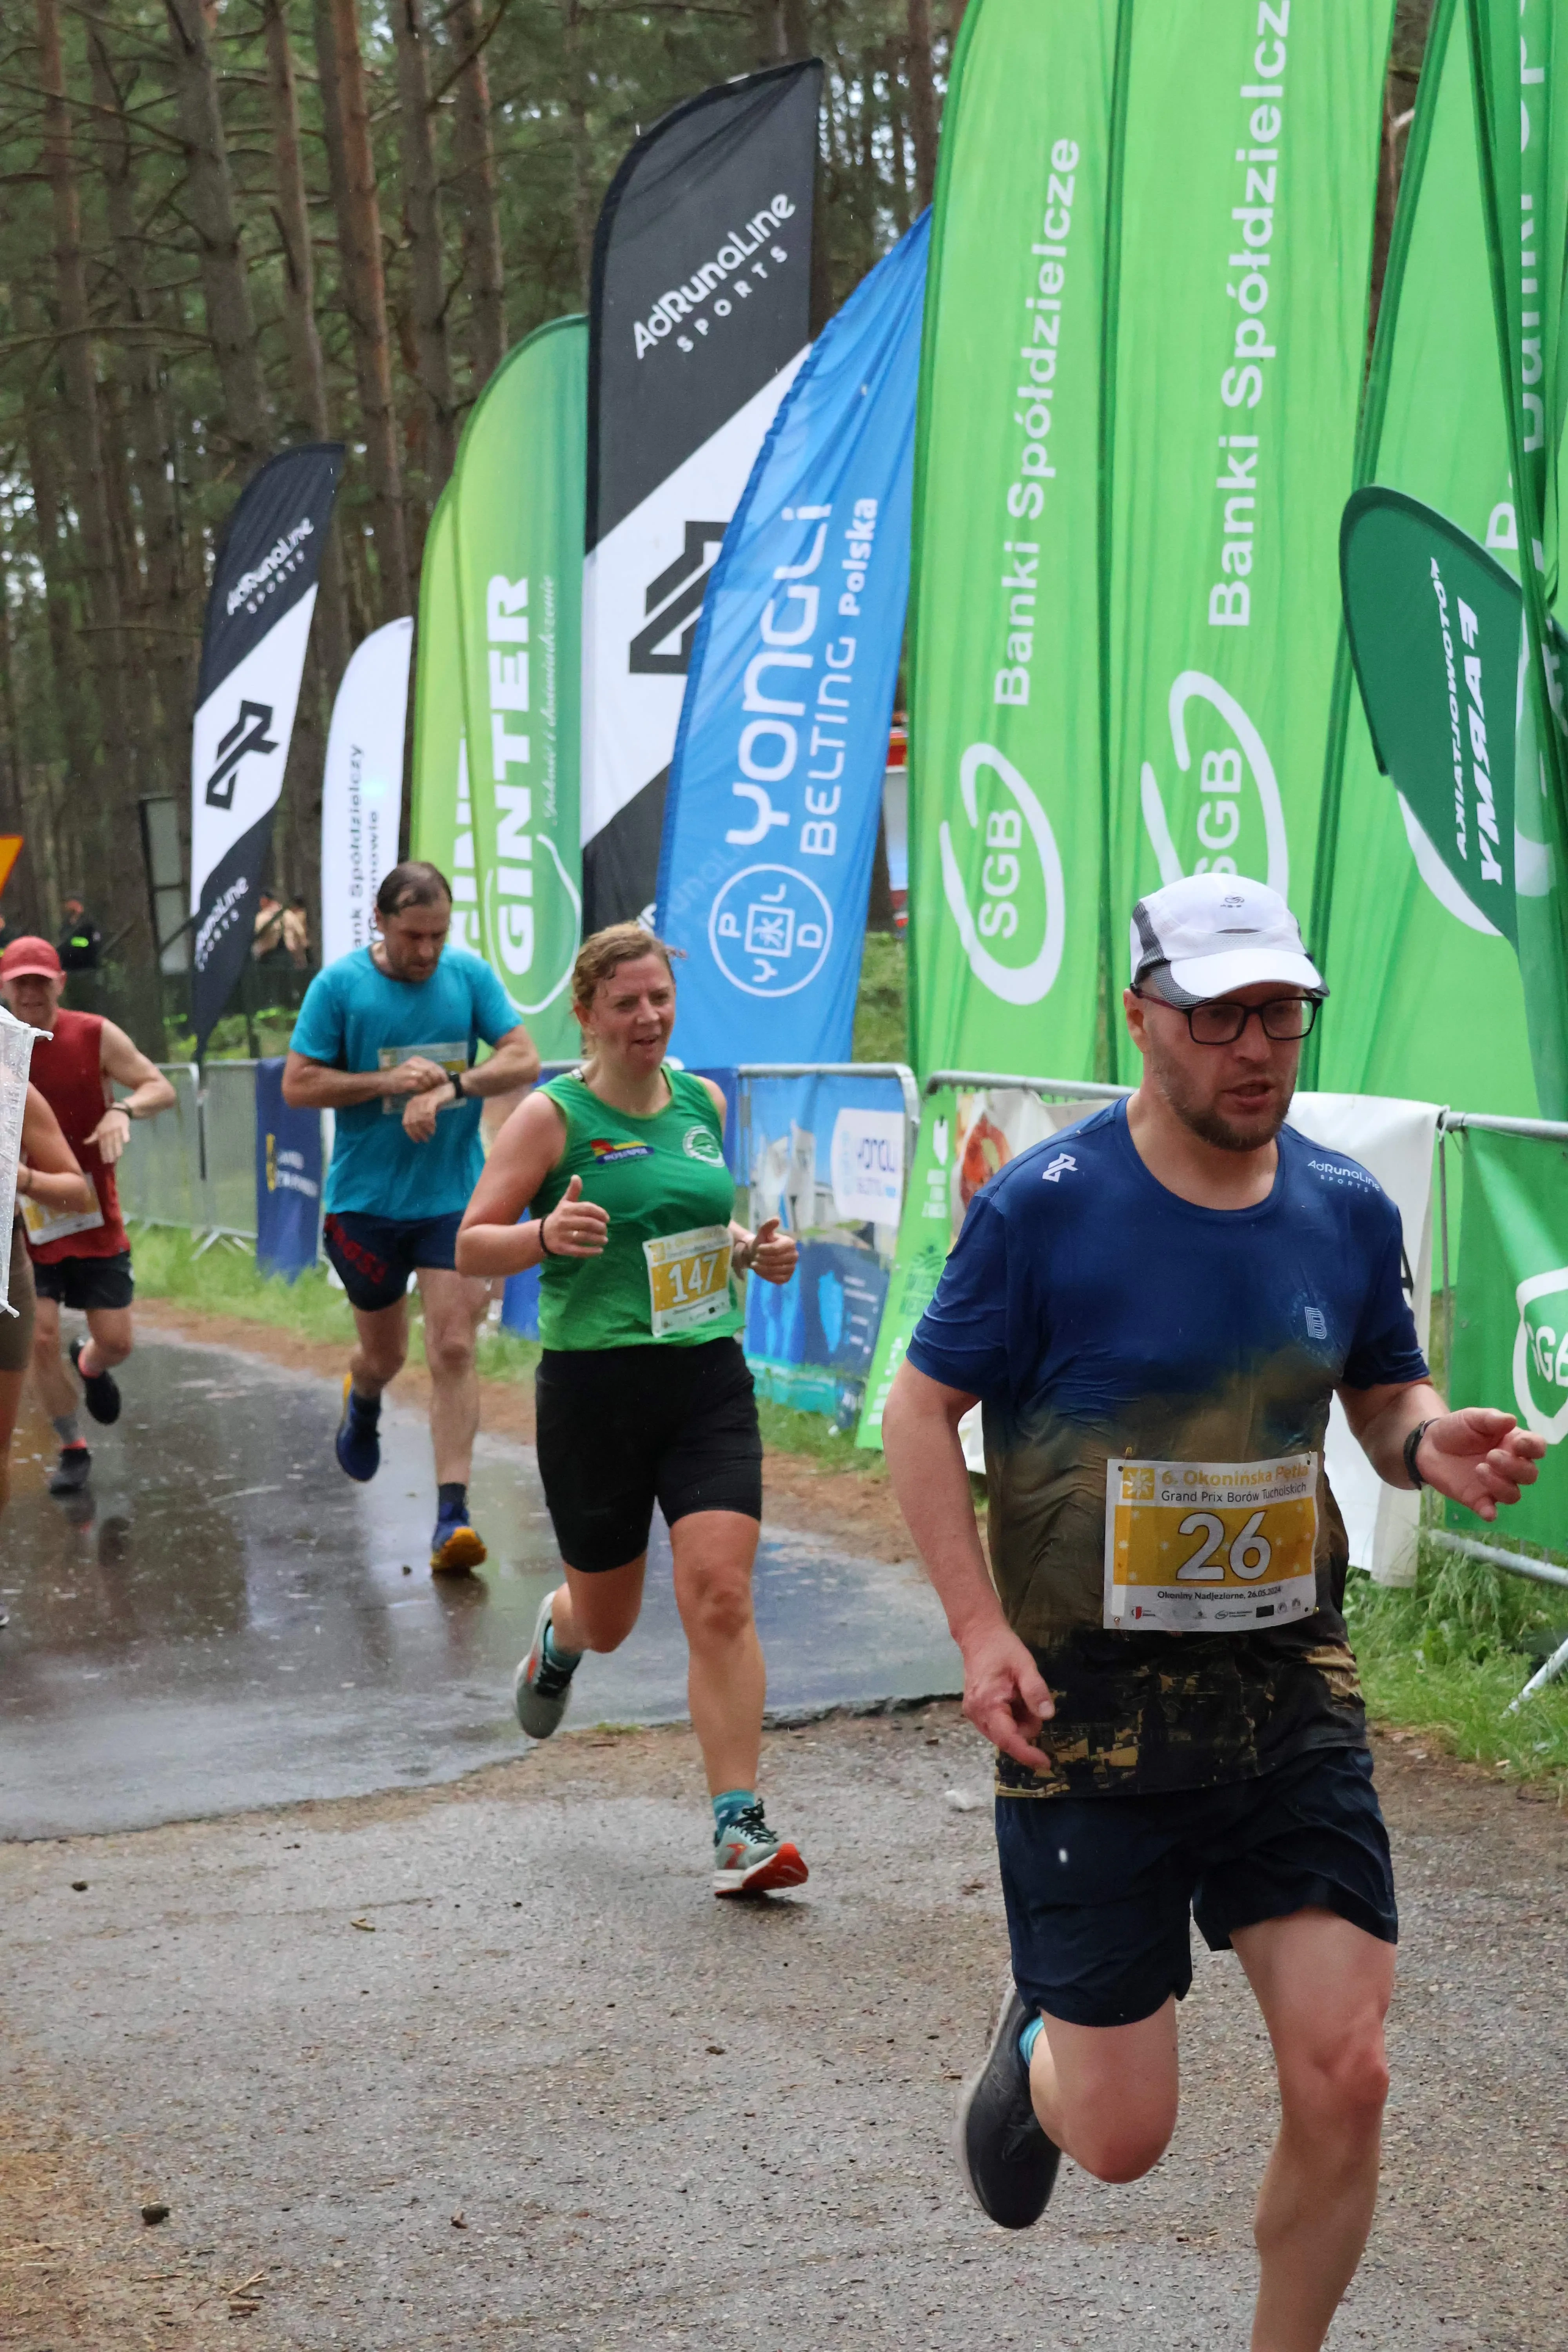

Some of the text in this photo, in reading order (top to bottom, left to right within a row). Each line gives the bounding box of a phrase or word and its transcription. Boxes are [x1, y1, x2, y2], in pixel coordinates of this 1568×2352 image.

[677, 245, 788, 352] SPORTS
[994, 138, 1080, 706] Banki Spółdzielcze
[1209, 434, 1259, 626] Banki
[800, 497, 878, 855] BELTING Polska
[486, 574, 535, 976] GINTER
[978, 808, 1022, 939] SGB
[350, 907, 363, 948] ank
[1307, 1160, 1380, 1192] AdRunaLine
[1320, 1174, 1368, 1192] SPORTS
[669, 1252, 719, 1303] 147
[1161, 1482, 1307, 1503] Grand Prix Borów Tucholskich
[1182, 1469, 1272, 1486] Okonińska
[1176, 1510, 1272, 1581] 26
